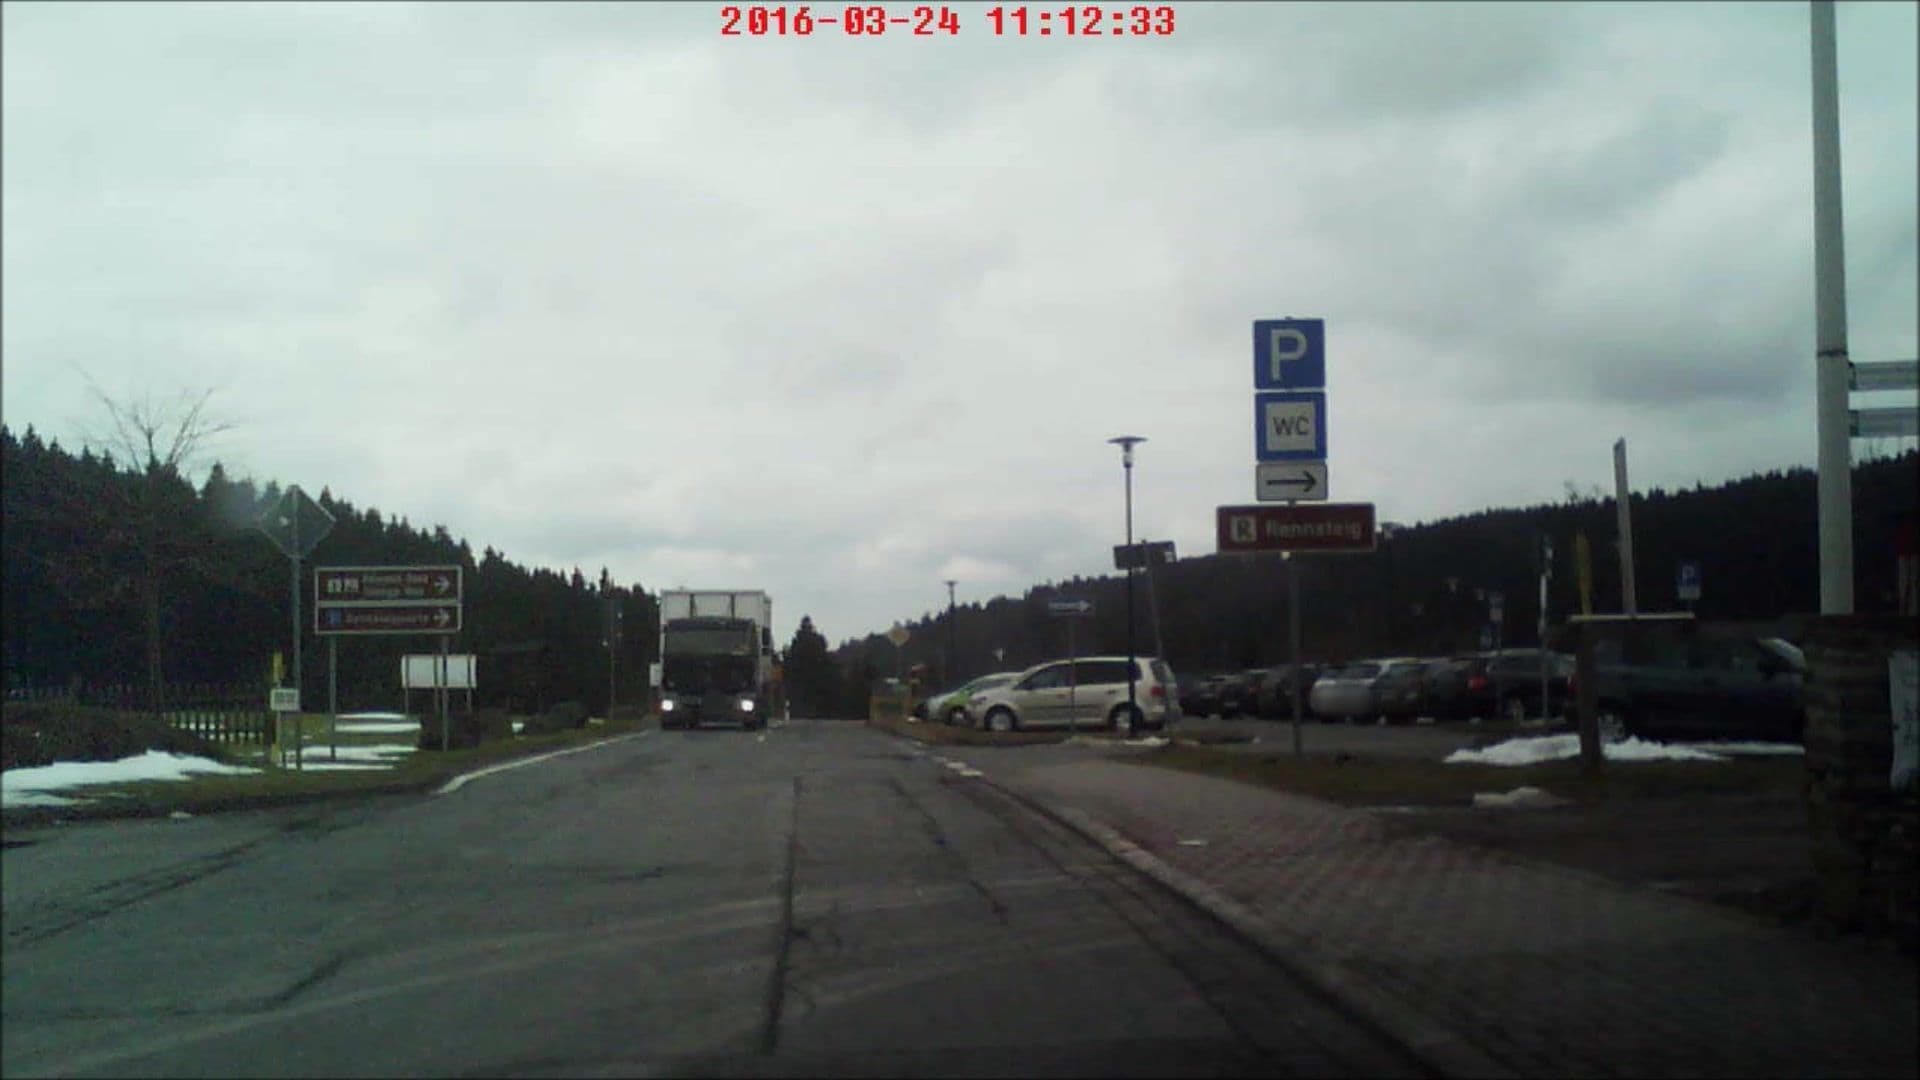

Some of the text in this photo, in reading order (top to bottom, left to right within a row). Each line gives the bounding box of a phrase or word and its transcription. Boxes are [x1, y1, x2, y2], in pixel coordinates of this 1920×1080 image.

[1270, 329, 1308, 382] P
[1273, 416, 1310, 436] WC
[1265, 518, 1362, 540] Rennsteig
